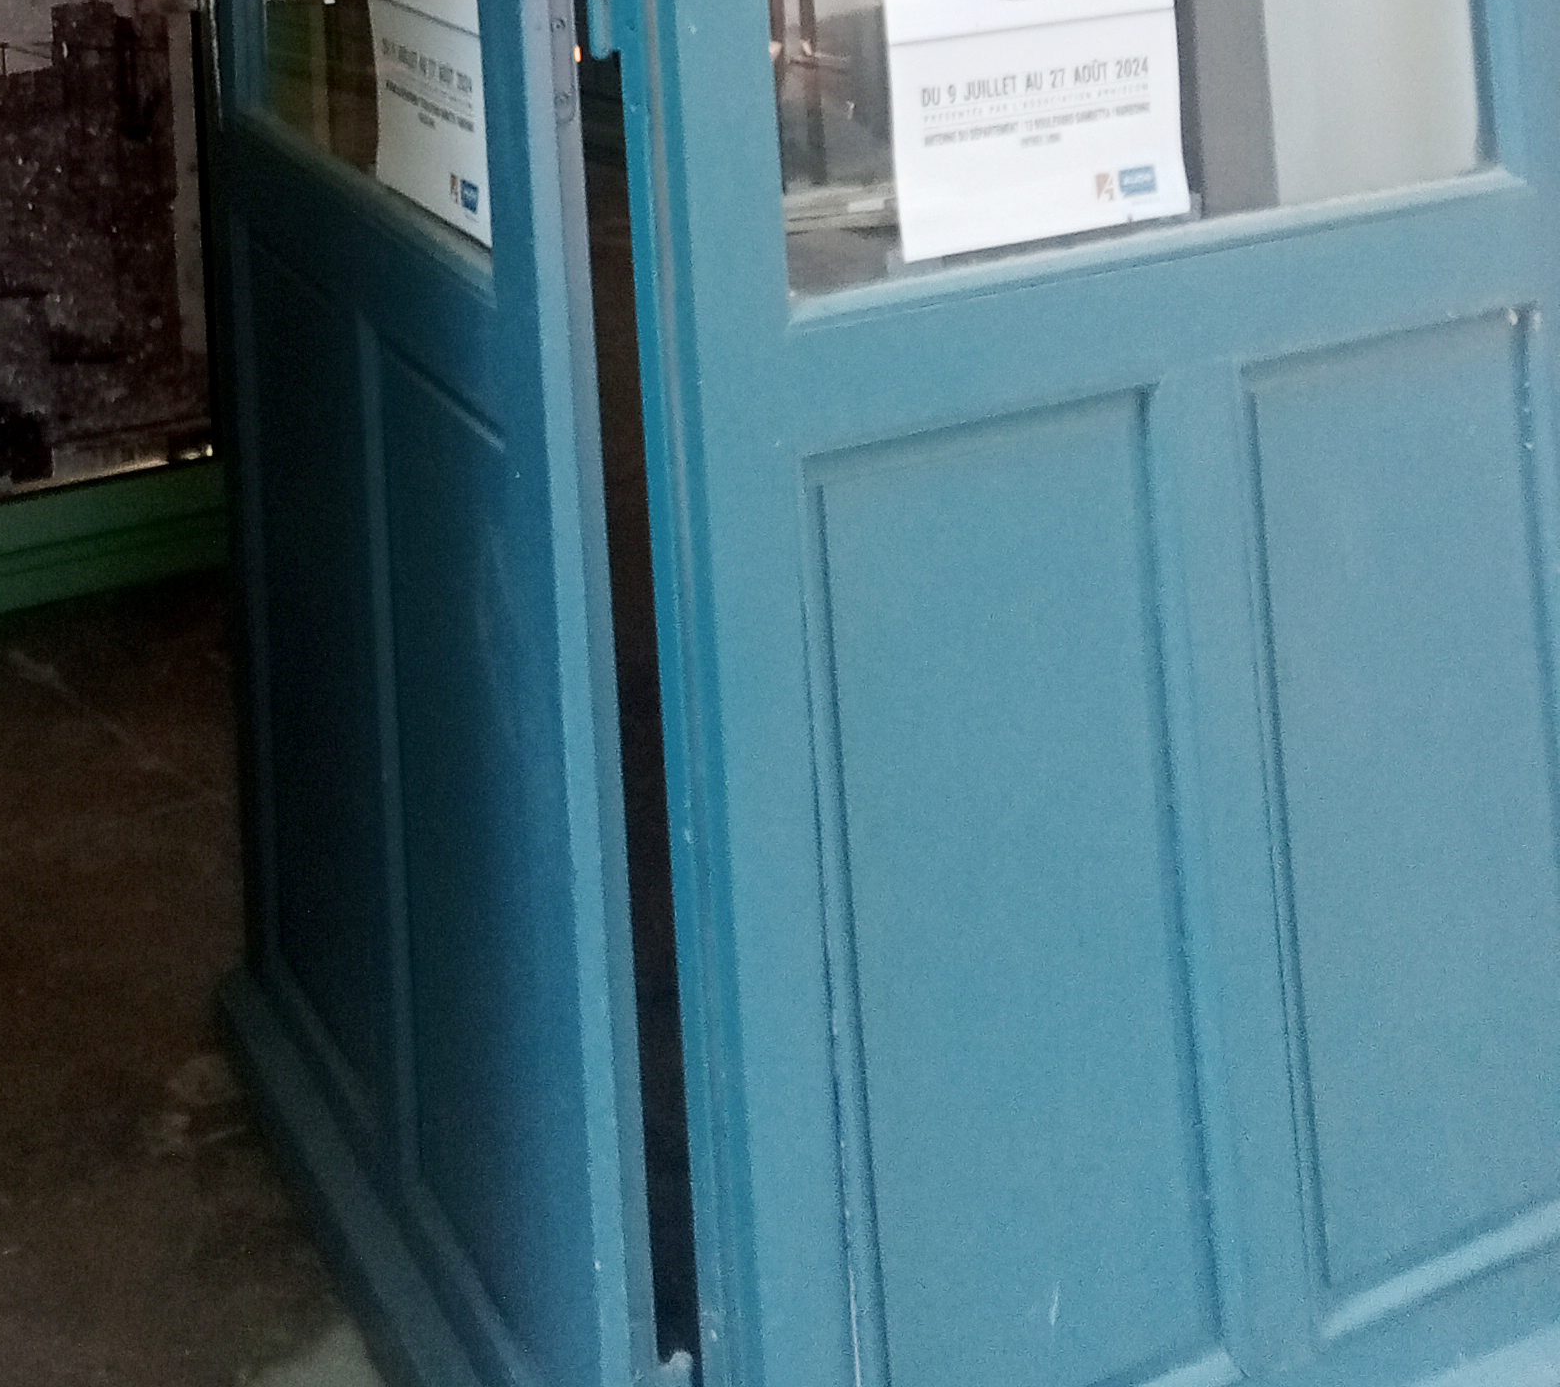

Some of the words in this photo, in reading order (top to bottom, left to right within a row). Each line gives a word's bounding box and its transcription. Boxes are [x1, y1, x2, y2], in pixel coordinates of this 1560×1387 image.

[921, 87, 941, 108] DU
[947, 84, 957, 104] 9
[963, 75, 1017, 102] JUILLET
[1025, 71, 1043, 93] AU
[1050, 68, 1066, 88] 27
[1073, 59, 1108, 84] AOÛT
[1115, 56, 1149, 80] 2024
